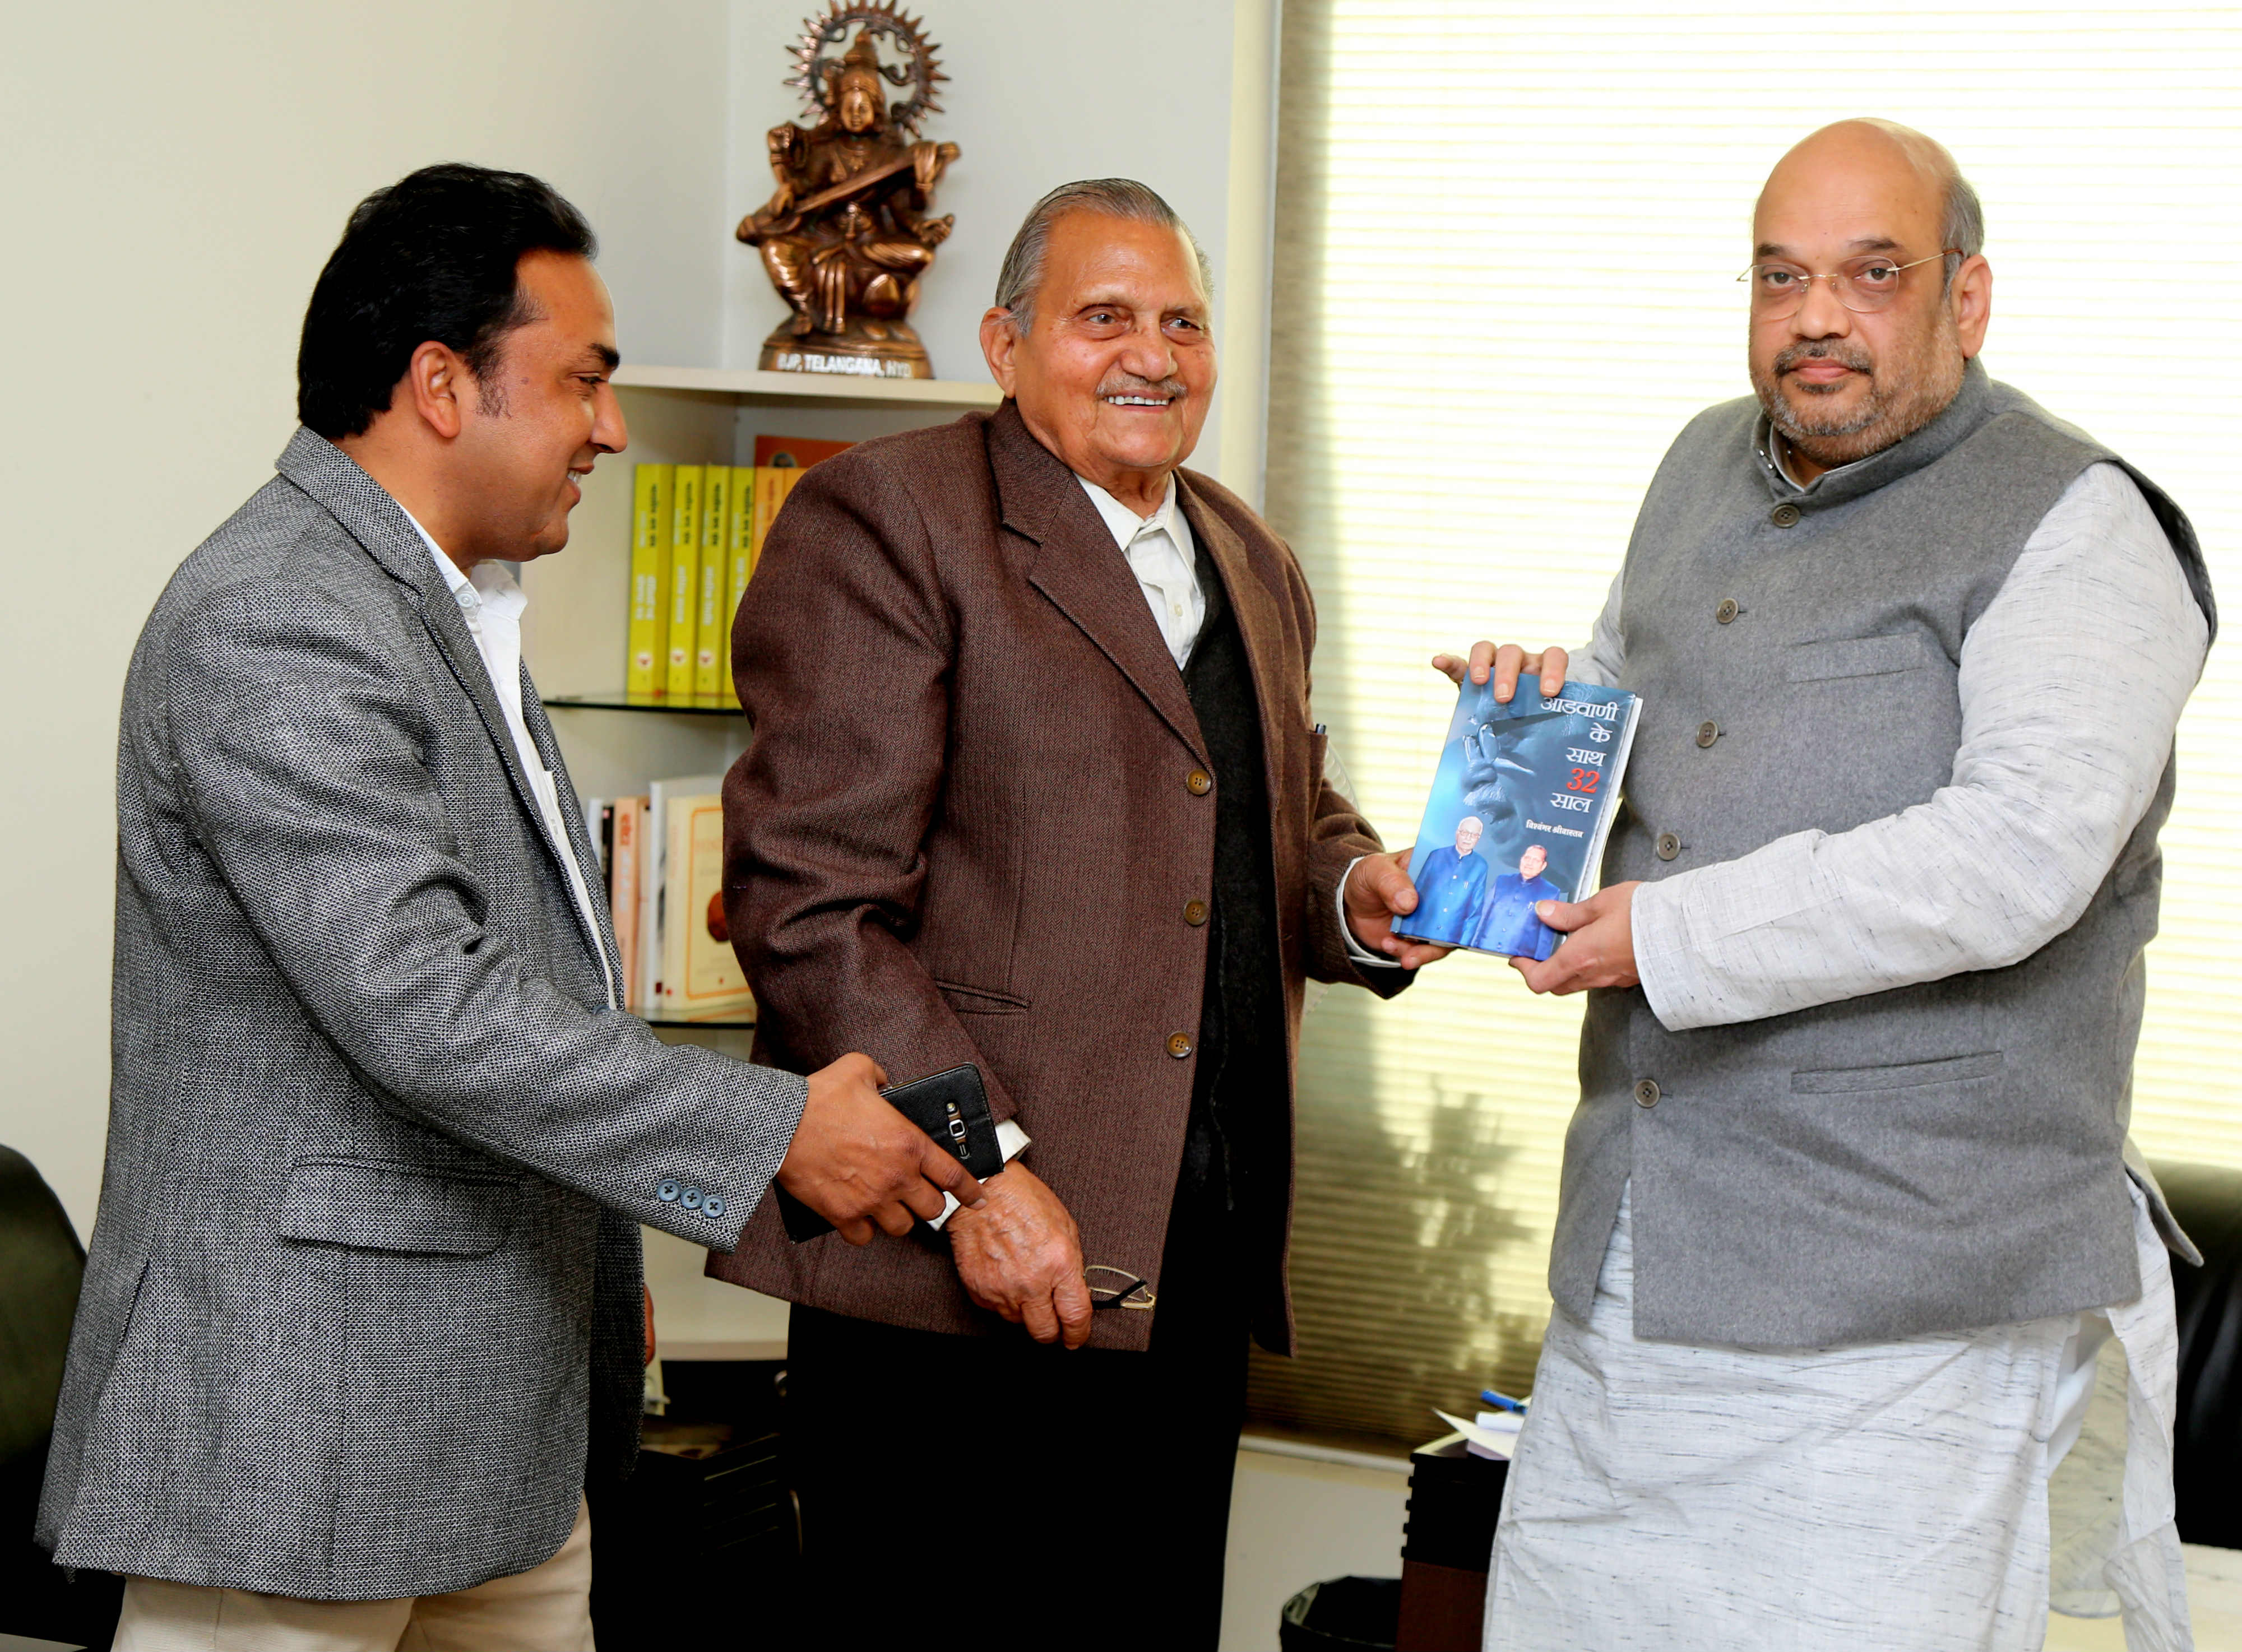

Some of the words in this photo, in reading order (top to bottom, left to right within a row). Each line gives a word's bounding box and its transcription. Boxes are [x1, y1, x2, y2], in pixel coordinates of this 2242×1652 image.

[1541, 697, 1619, 721] आडवाणी
[1590, 722, 1613, 743] के
[1565, 747, 1606, 767] साथ
[1566, 768, 1600, 793] 32
[1550, 792, 1594, 813] साल
